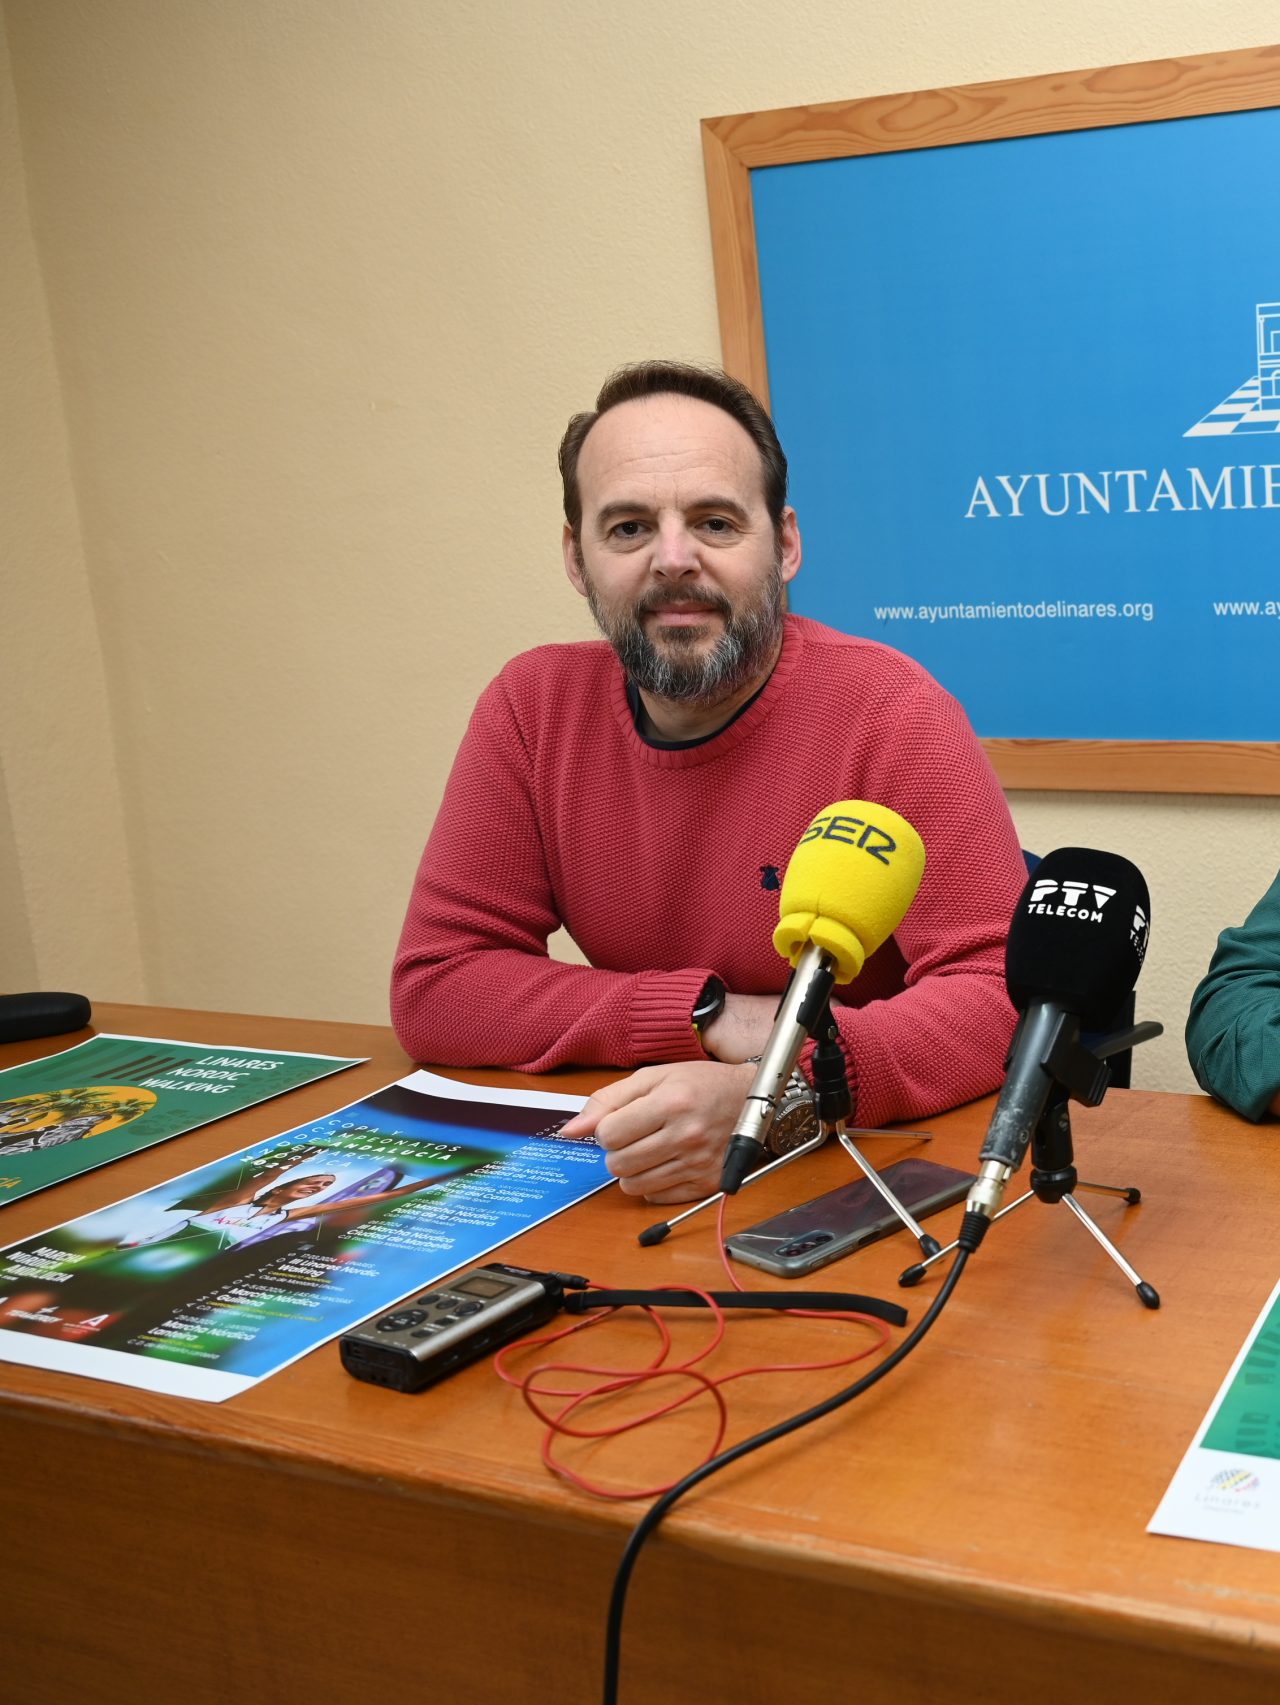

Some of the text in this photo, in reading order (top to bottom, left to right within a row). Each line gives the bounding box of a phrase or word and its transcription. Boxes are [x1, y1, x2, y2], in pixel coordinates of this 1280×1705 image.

[874, 600, 1153, 622] www.ayuntamientodelinares.org
[800, 815, 896, 865] SER
[1028, 903, 1103, 923] TELECOM
[195, 1056, 284, 1070] LINARES
[166, 1068, 250, 1080] NORDIC
[138, 1078, 235, 1093] WALKING
[328, 1119, 379, 1133] COPA
[311, 1126, 462, 1152] CAMPEONATOS
[277, 1264, 325, 1277] Walking
[301, 1260, 342, 1271] Linares
[341, 1266, 381, 1277] Nordic
[229, 1288, 275, 1299] Marcha
[161, 1320, 210, 1333] Marcha
